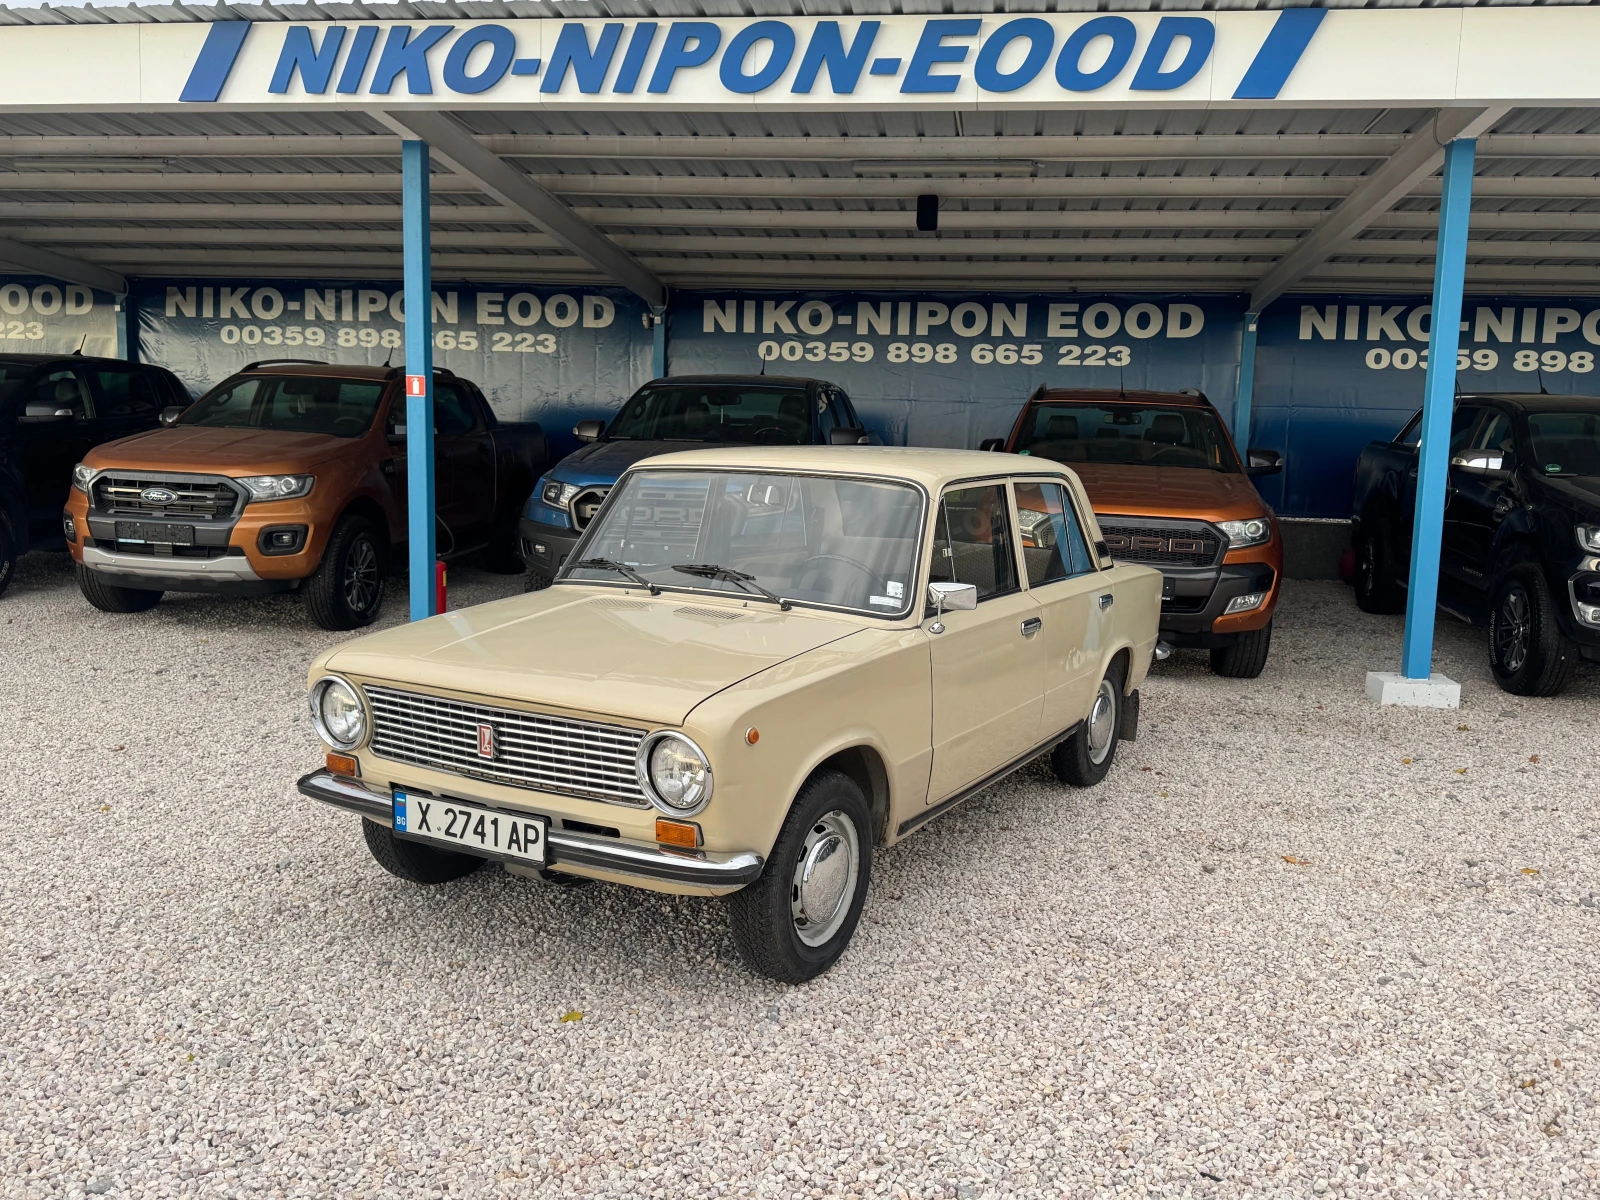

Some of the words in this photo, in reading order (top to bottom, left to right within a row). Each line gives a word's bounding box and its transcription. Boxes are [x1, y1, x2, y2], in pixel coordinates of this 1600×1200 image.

[268, 15, 1215, 95] NIKO-NIPON-EOOD
[476, 292, 616, 329] EOOD
[703, 299, 1028, 338] NIKO-NIPON
[1047, 302, 1205, 339] EOOD
[0, 320, 45, 340] 23
[220, 324, 326, 347] 00359
[337, 327, 402, 349] 898
[431, 330, 479, 351] 65
[492, 332, 557, 354] 223
[757, 340, 875, 363] 00359
[887, 342, 958, 364] 898
[970, 343, 1044, 365] 665
[1057, 345, 1132, 367] 223
[1512, 350, 1595, 373] 898
[147, 491, 168, 502] Ford
[396, 815, 406, 826] BG
[417, 801, 432, 833] X
[444, 807, 499, 848] 2741
[507, 821, 540, 854] AP
